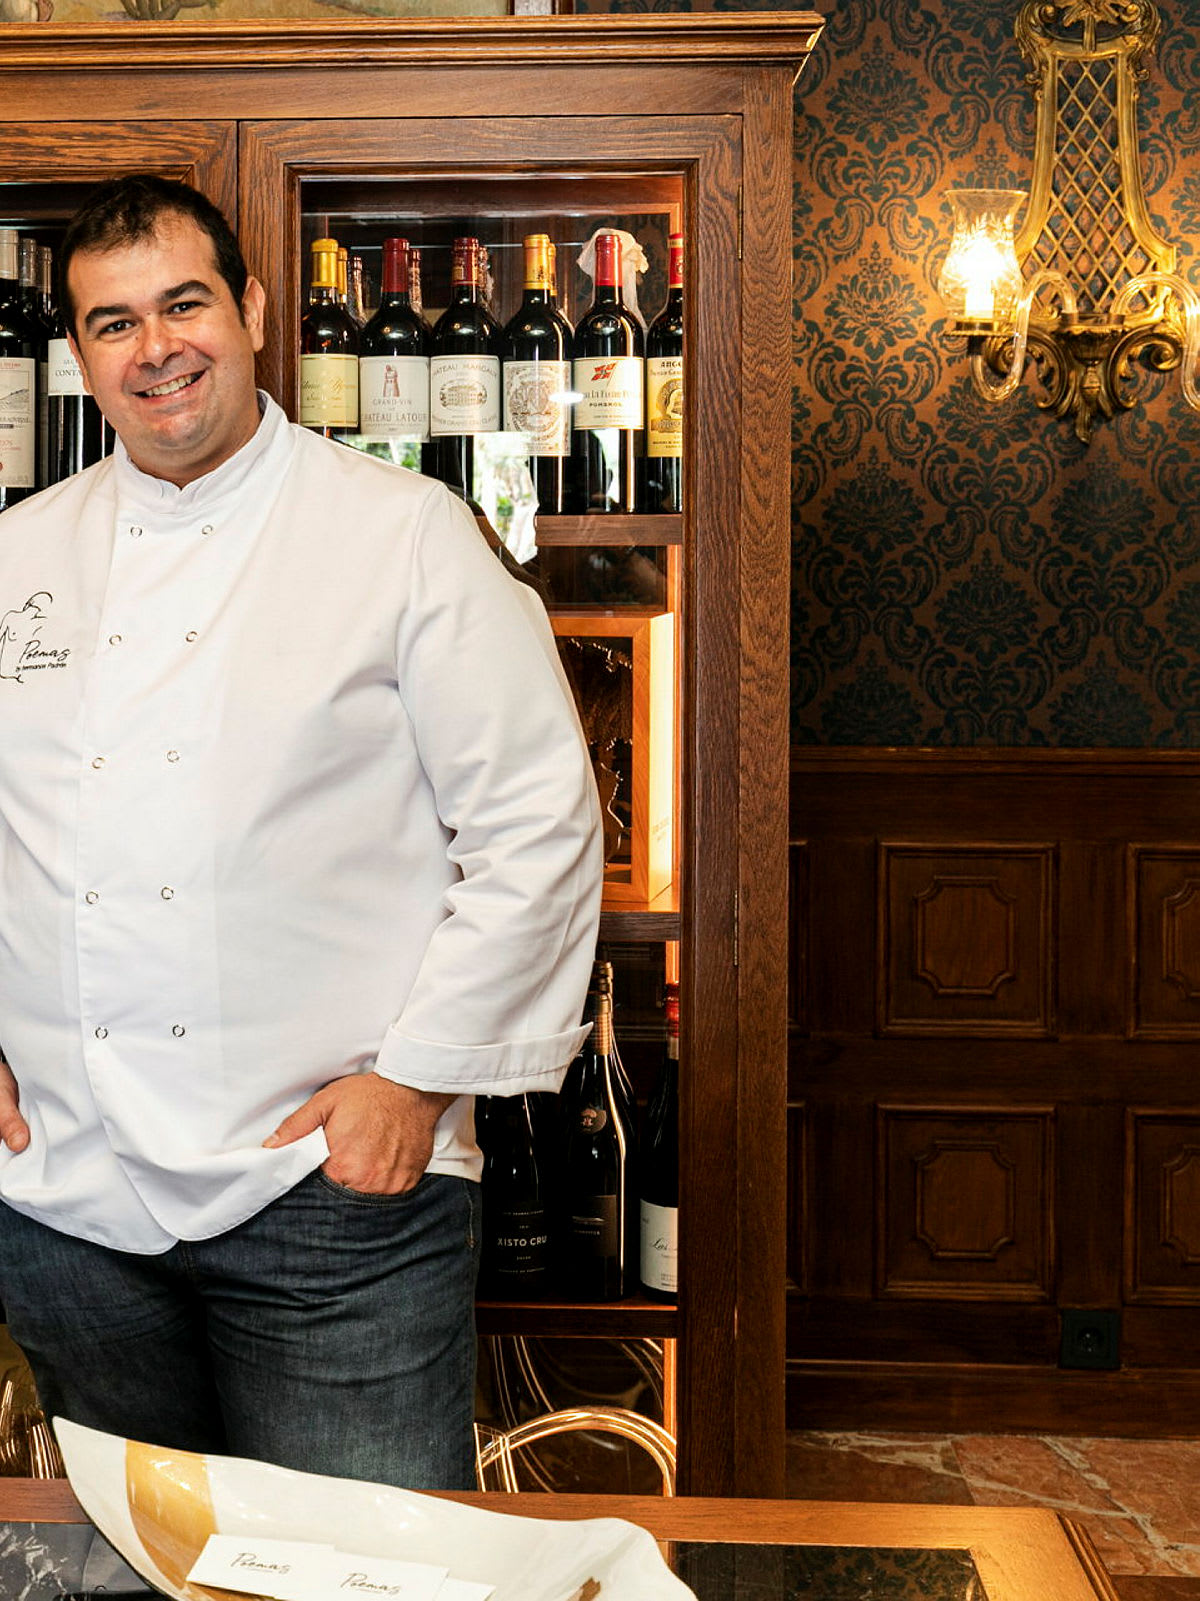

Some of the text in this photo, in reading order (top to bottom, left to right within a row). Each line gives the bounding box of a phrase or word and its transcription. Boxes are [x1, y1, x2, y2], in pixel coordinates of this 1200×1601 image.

[18, 639, 71, 664] Poemas
[497, 1237, 527, 1247] XISTO
[230, 1552, 292, 1575] Poemas
[340, 1572, 402, 1596] Poemas
